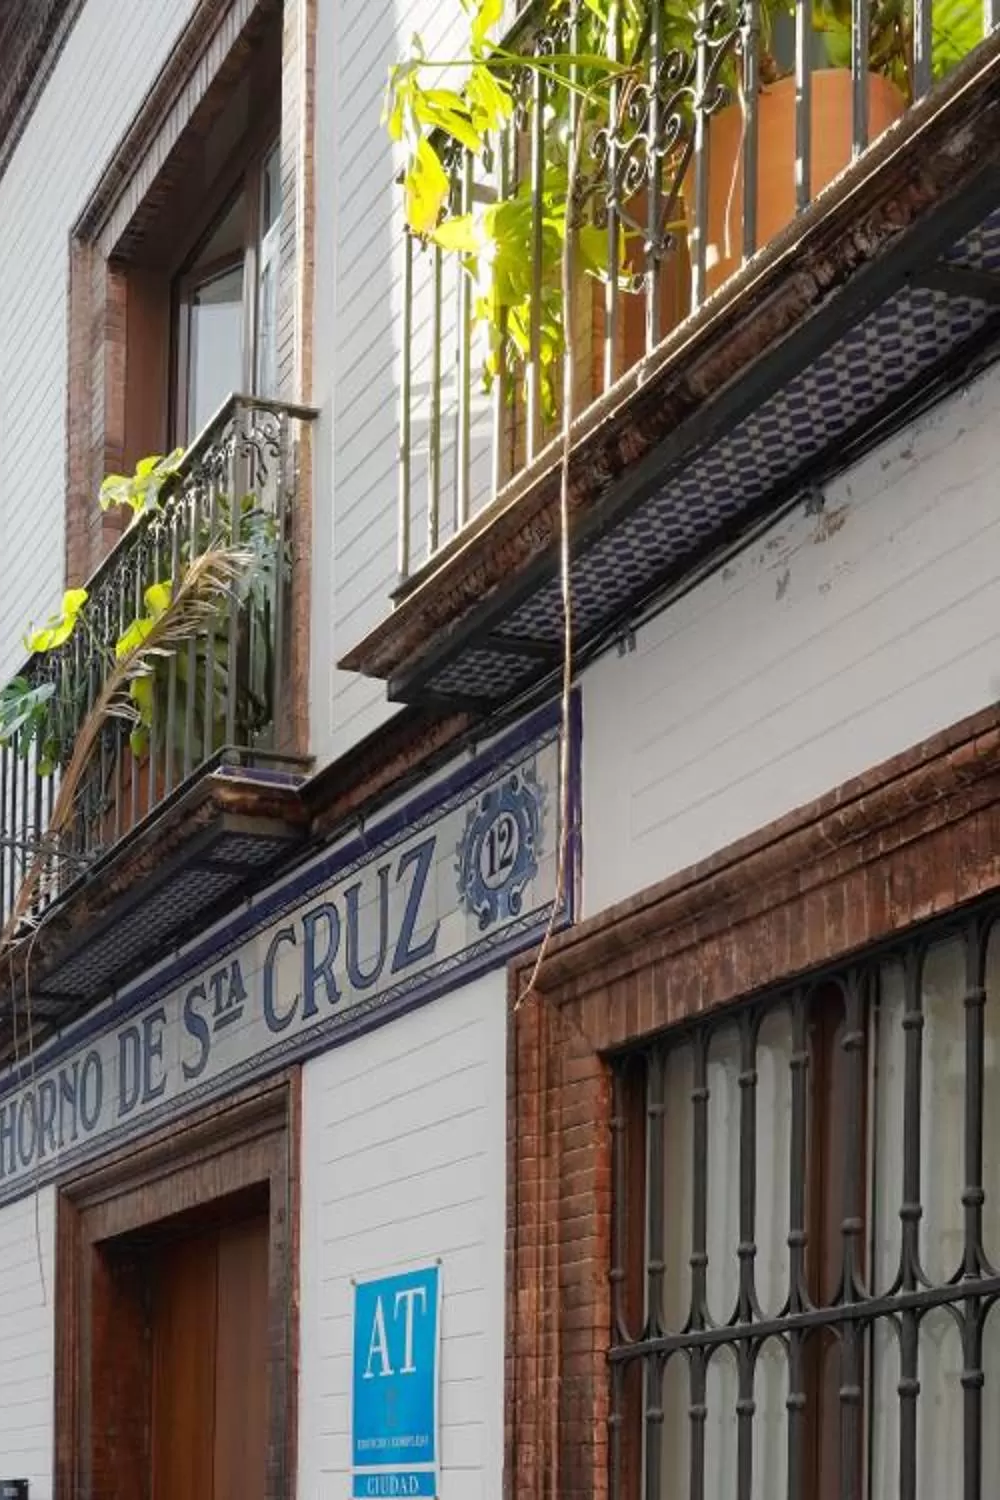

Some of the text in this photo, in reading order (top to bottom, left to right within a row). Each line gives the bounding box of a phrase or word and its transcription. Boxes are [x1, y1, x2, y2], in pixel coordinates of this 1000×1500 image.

[485, 816, 515, 879] 12
[117, 1007, 168, 1118] DE
[263, 834, 441, 1033] CRUZ
[362, 1287, 427, 1379] AT
[367, 1474, 420, 1496] CIUDAD
